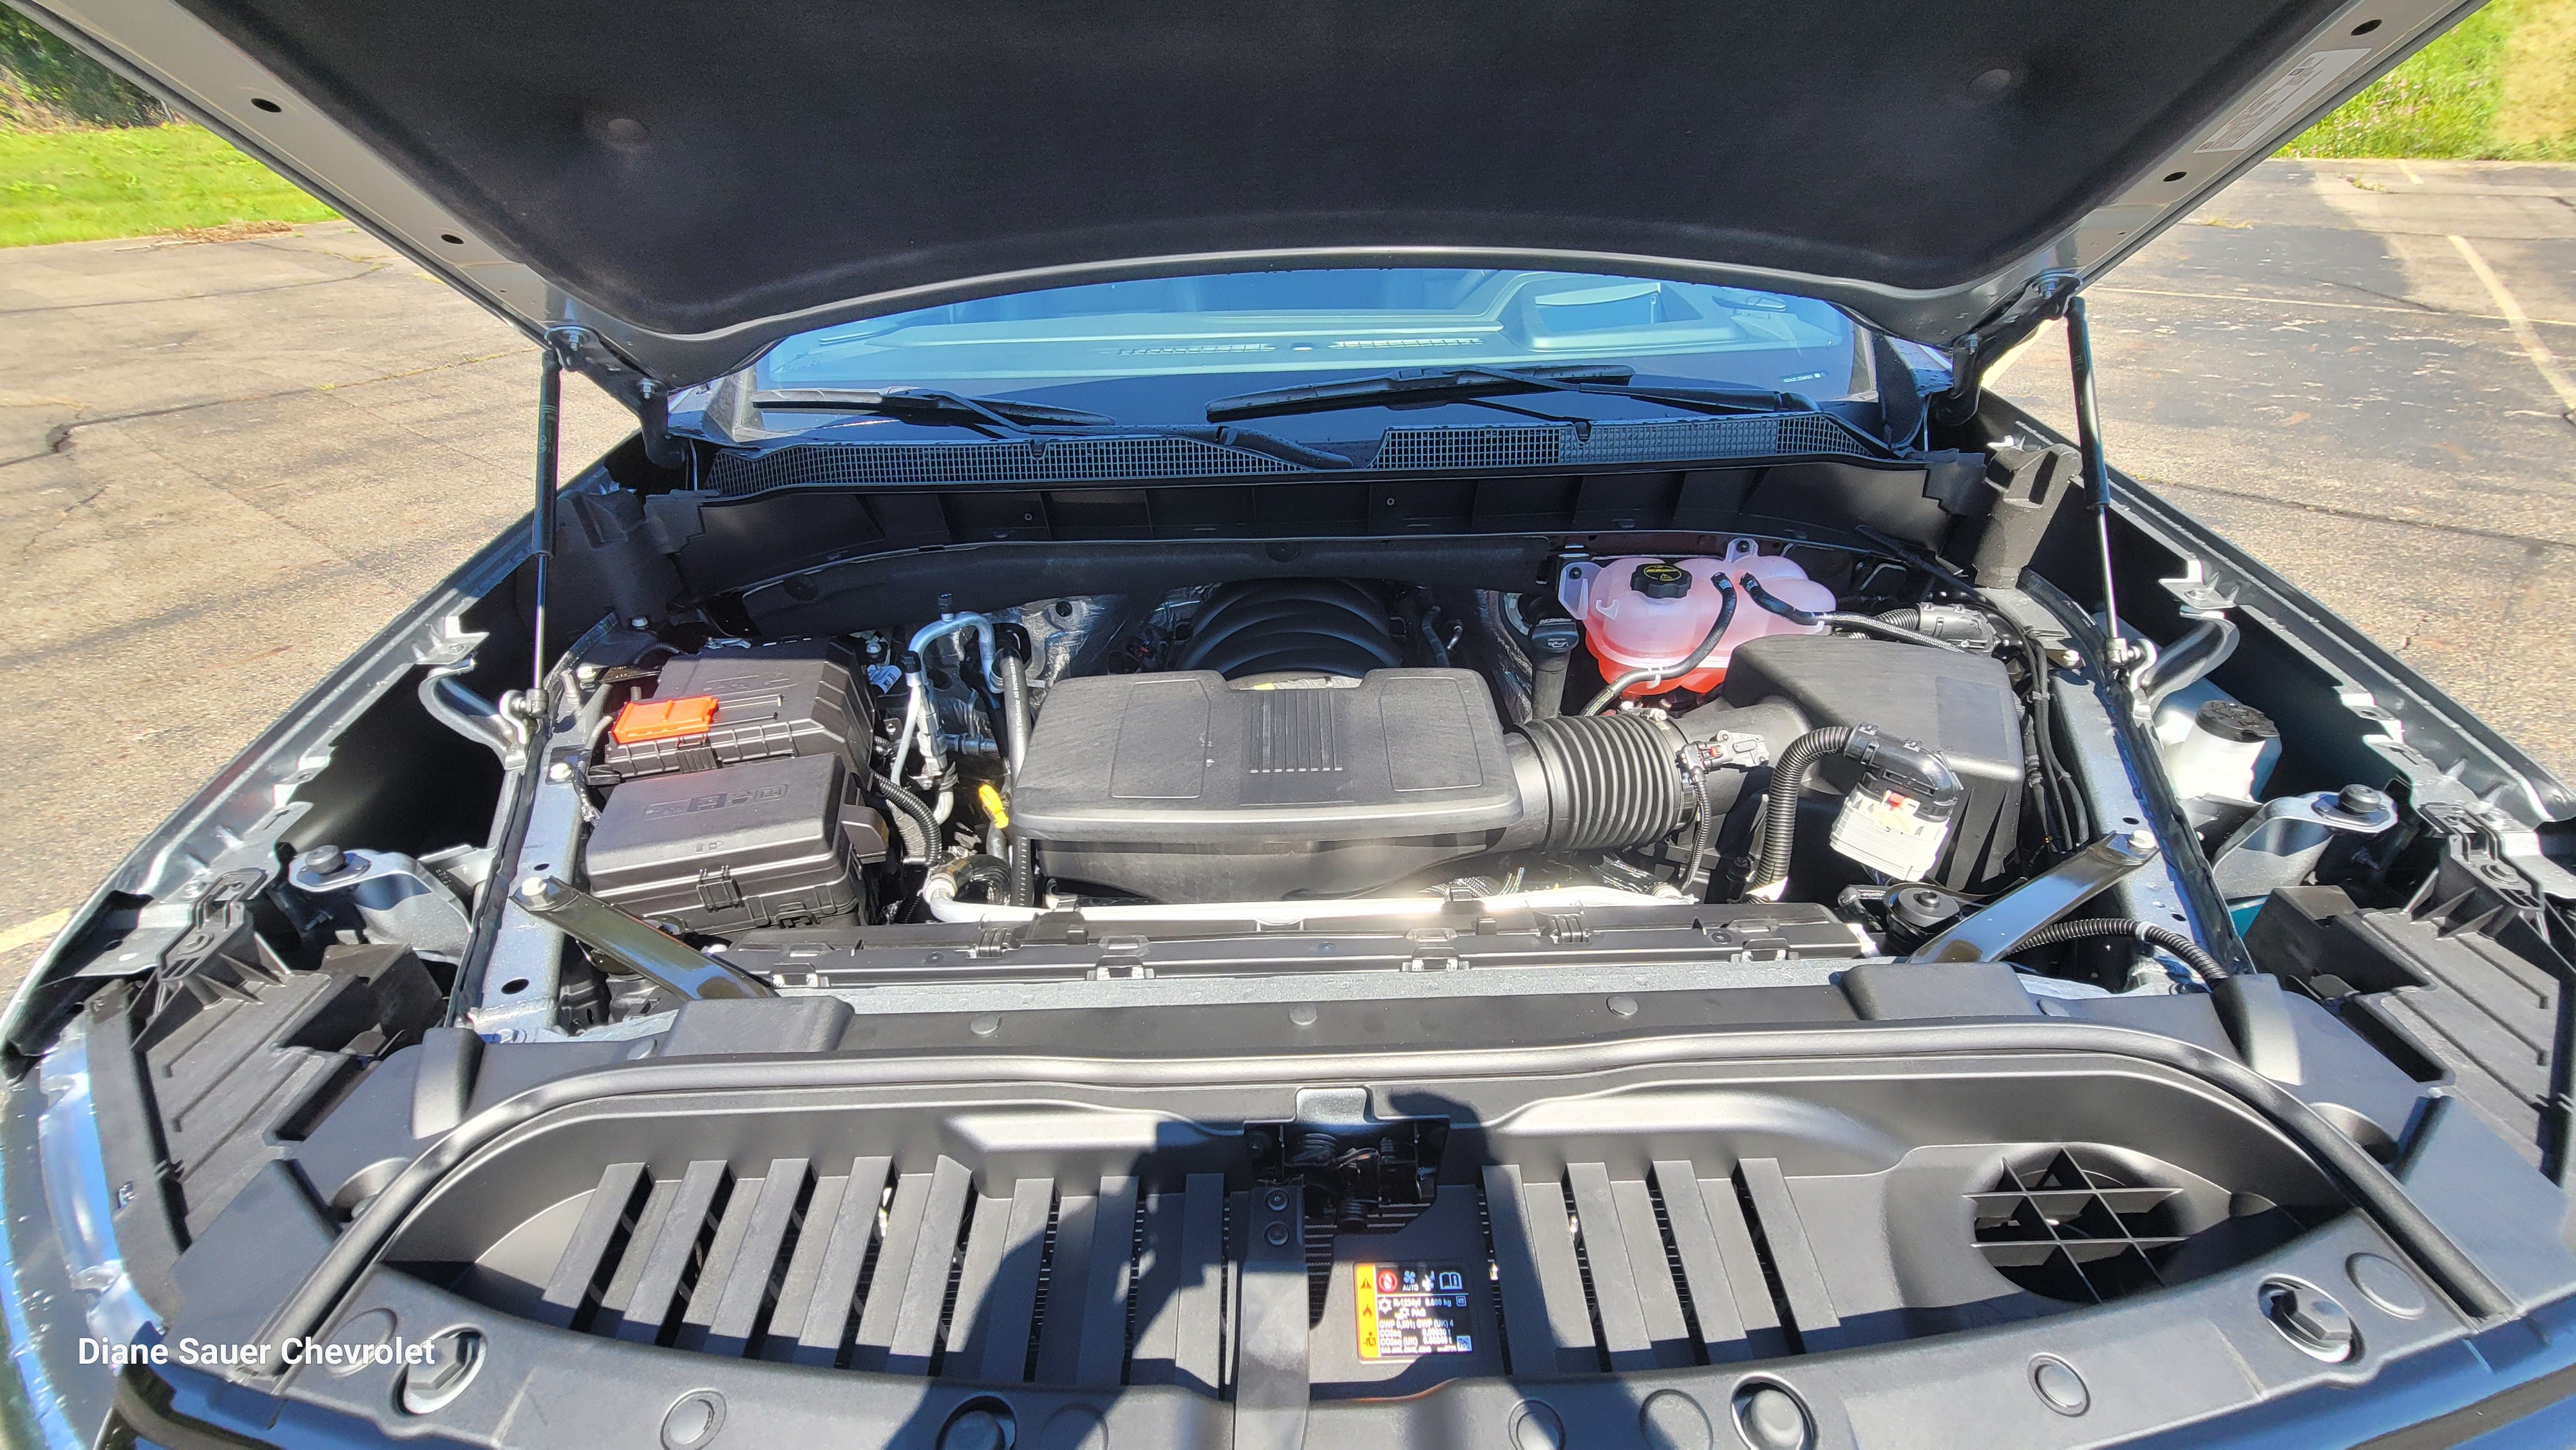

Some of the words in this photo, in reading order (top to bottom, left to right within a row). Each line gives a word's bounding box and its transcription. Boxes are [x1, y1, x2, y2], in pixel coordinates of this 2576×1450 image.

[1443, 1298, 1452, 1307] kg
[1379, 1319, 1395, 1328] GWP
[1416, 1319, 1432, 1328] GWP
[1434, 1319, 1448, 1328] (UK)
[1450, 1319, 1454, 1327] 4
[1403, 1336, 1418, 1347] (UK)
